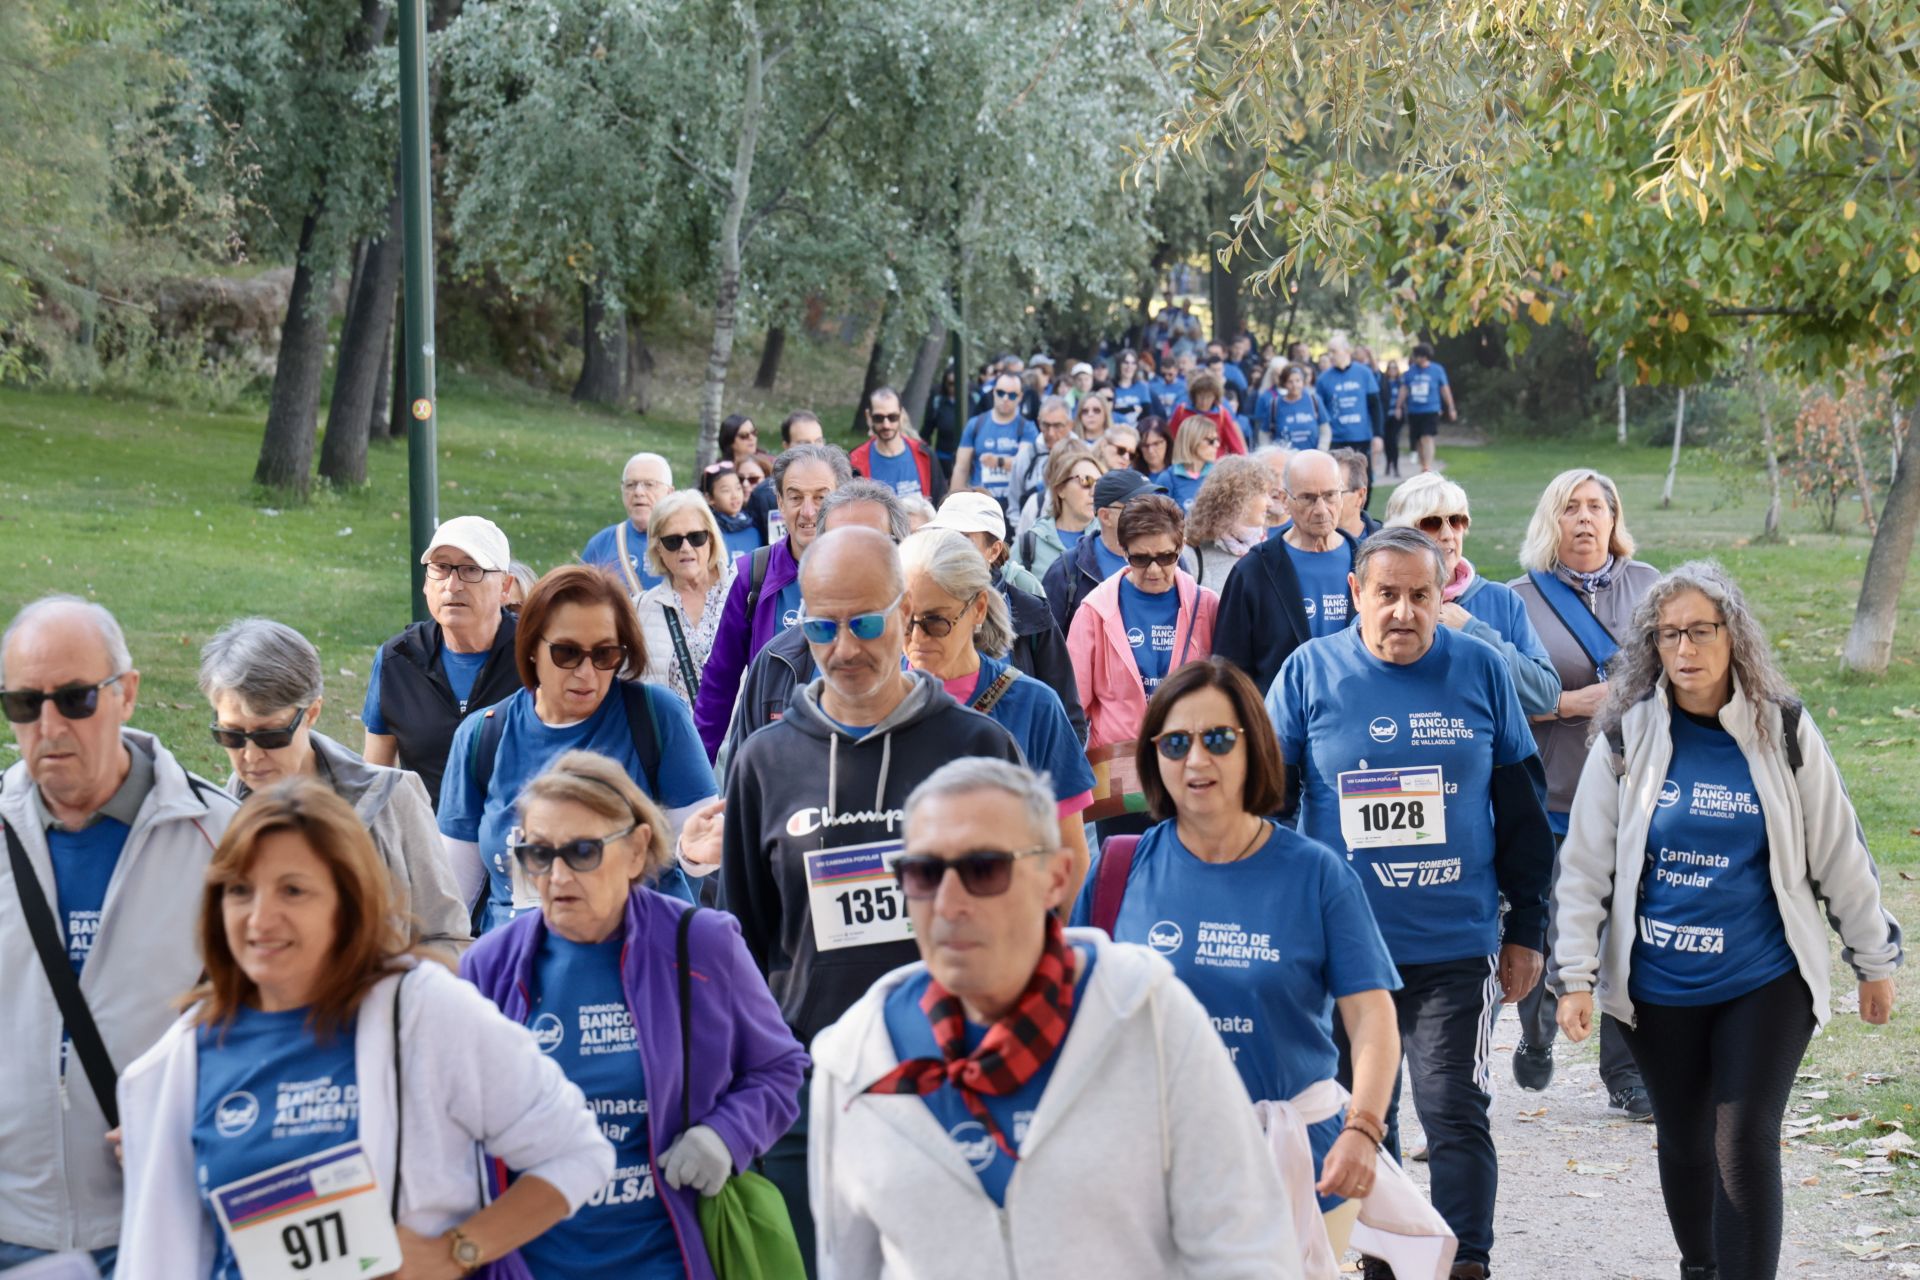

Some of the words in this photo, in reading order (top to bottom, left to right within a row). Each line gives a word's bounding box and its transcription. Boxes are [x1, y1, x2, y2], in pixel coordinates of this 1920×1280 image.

[1410, 718, 1449, 729] BANCO
[1451, 718, 1464, 729] DE
[1411, 728, 1474, 739] ALIMENTOS
[1694, 782, 1727, 790] FUNDACIÓN
[1692, 788, 1733, 800] BANCO
[1736, 792, 1751, 803] DE
[1691, 799, 1759, 814] ALIMENTOS
[1358, 800, 1425, 832] 1028
[1419, 857, 1462, 870] COMERCIAL
[1660, 847, 1729, 868] Caminata
[1418, 866, 1462, 887] ULSA
[1657, 868, 1713, 888] Popular
[1199, 921, 1240, 932] FUNDACIÓN
[1677, 925, 1724, 936] COMERCIAL
[1198, 930, 1247, 945] BANCO
[1251, 933, 1271, 947] DE
[1674, 933, 1724, 954] ULSA
[1194, 956, 1205, 965] DE
[1196, 943, 1280, 962] ALIMENTOS
[579, 1012, 632, 1030] BANCO
[276, 1085, 341, 1111] BANCO
[281, 1210, 348, 1271] 977
